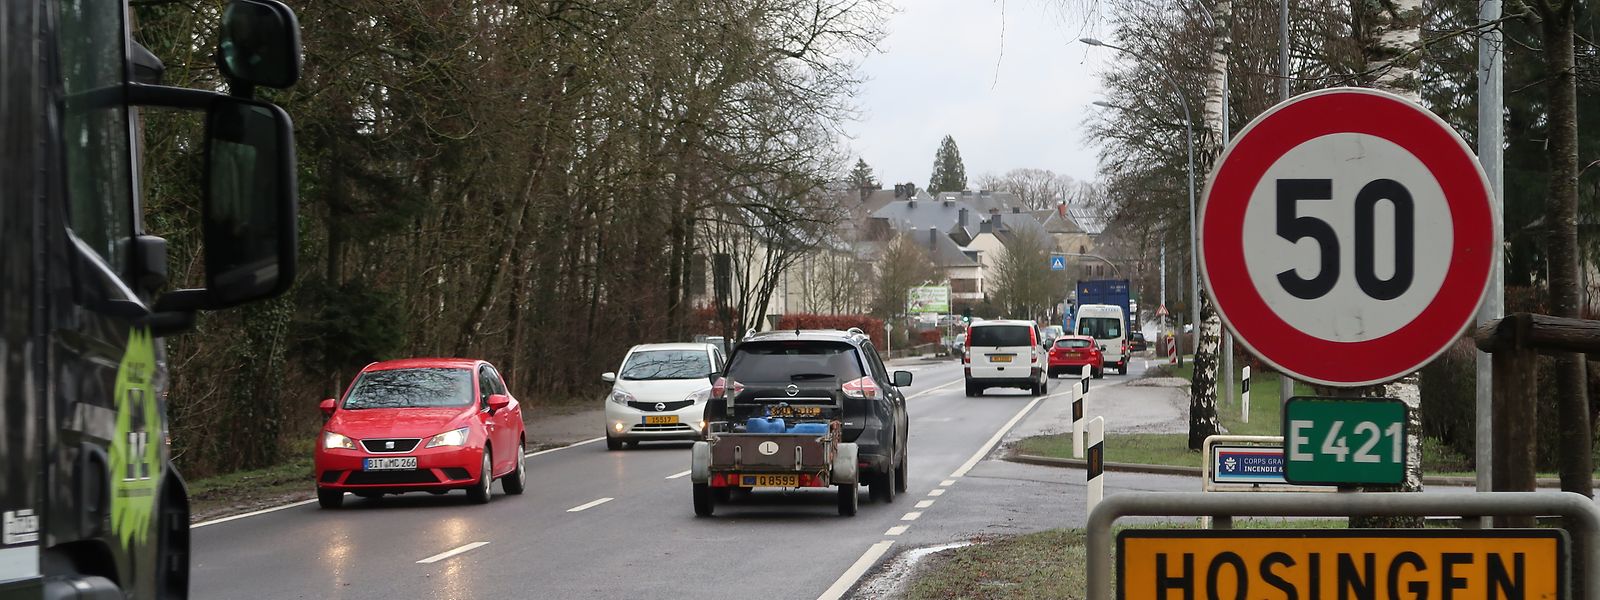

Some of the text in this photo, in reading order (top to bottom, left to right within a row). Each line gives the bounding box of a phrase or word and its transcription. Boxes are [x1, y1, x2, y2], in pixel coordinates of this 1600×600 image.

[1276, 178, 1414, 301] 50
[765, 443, 773, 453] L
[1289, 419, 1403, 463] E 421
[368, 458, 416, 468] BIT MC 266
[759, 475, 795, 486] Q 8599
[1155, 550, 1526, 600] HOSINGEN
